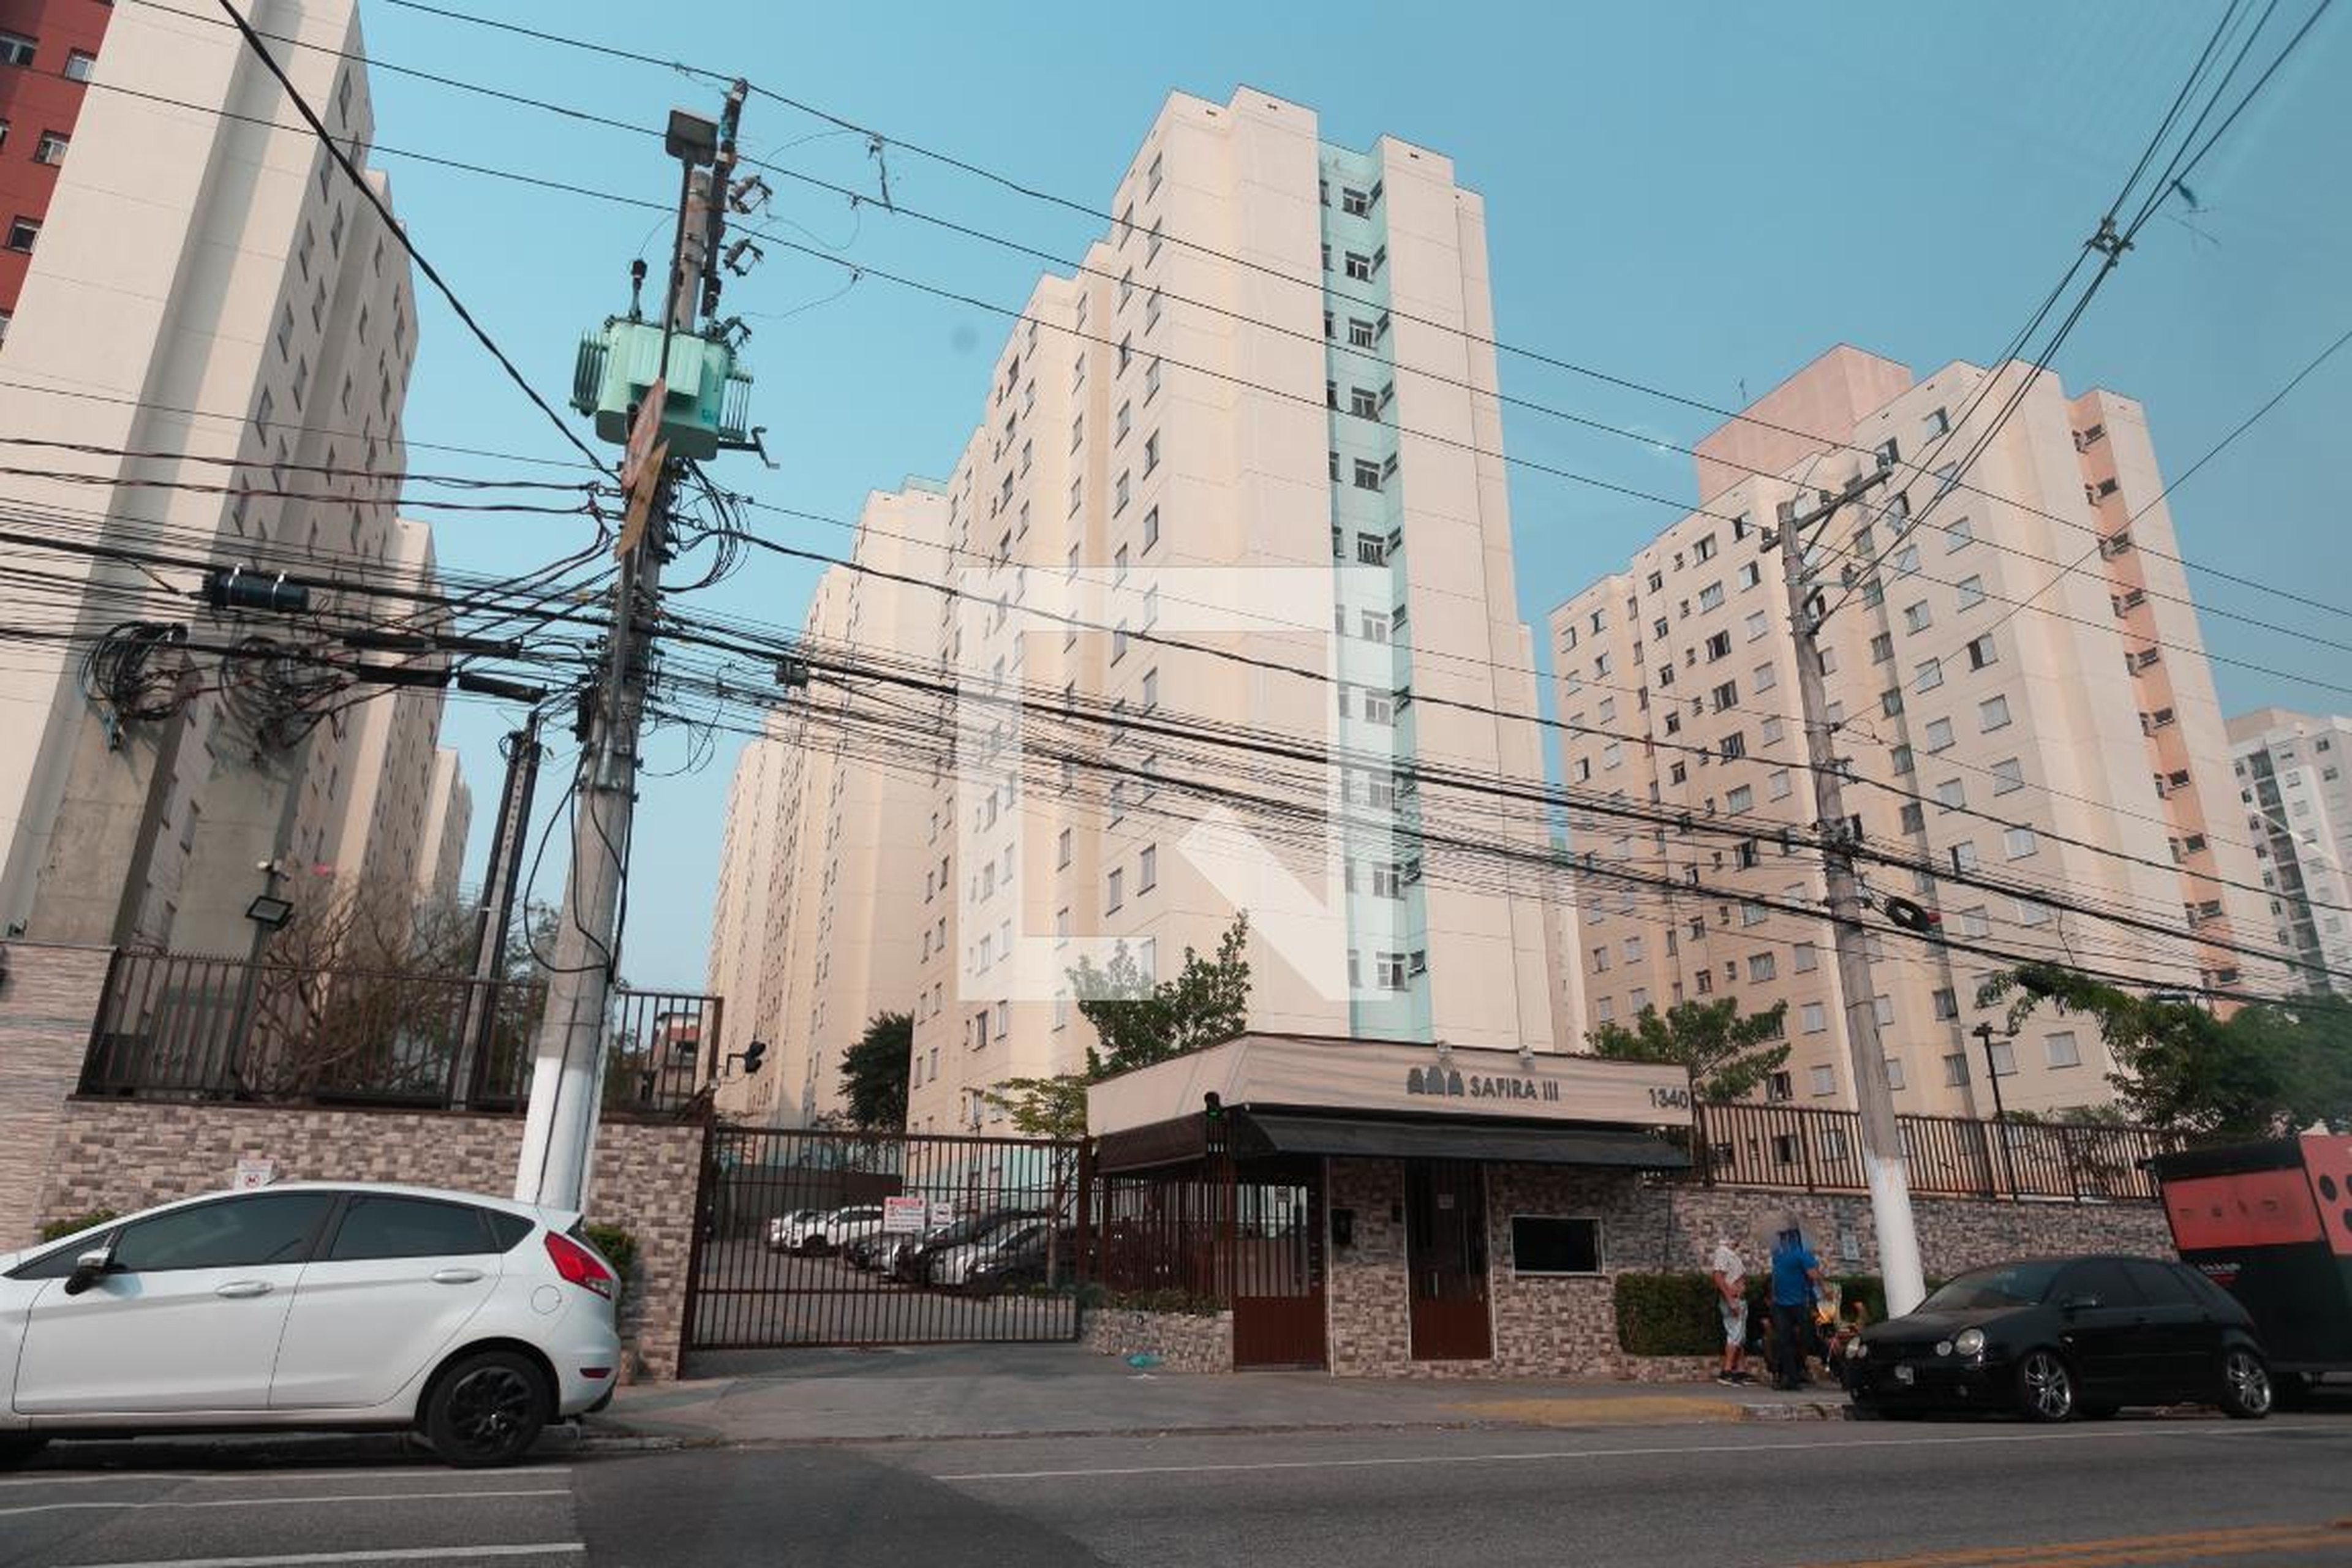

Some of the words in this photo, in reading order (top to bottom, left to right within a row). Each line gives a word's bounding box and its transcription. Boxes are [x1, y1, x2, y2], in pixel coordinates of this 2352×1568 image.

[1470, 1076, 1538, 1101] SAFIRA
[1542, 1080, 1559, 1102] III
[1649, 1088, 1689, 1109] 1340
